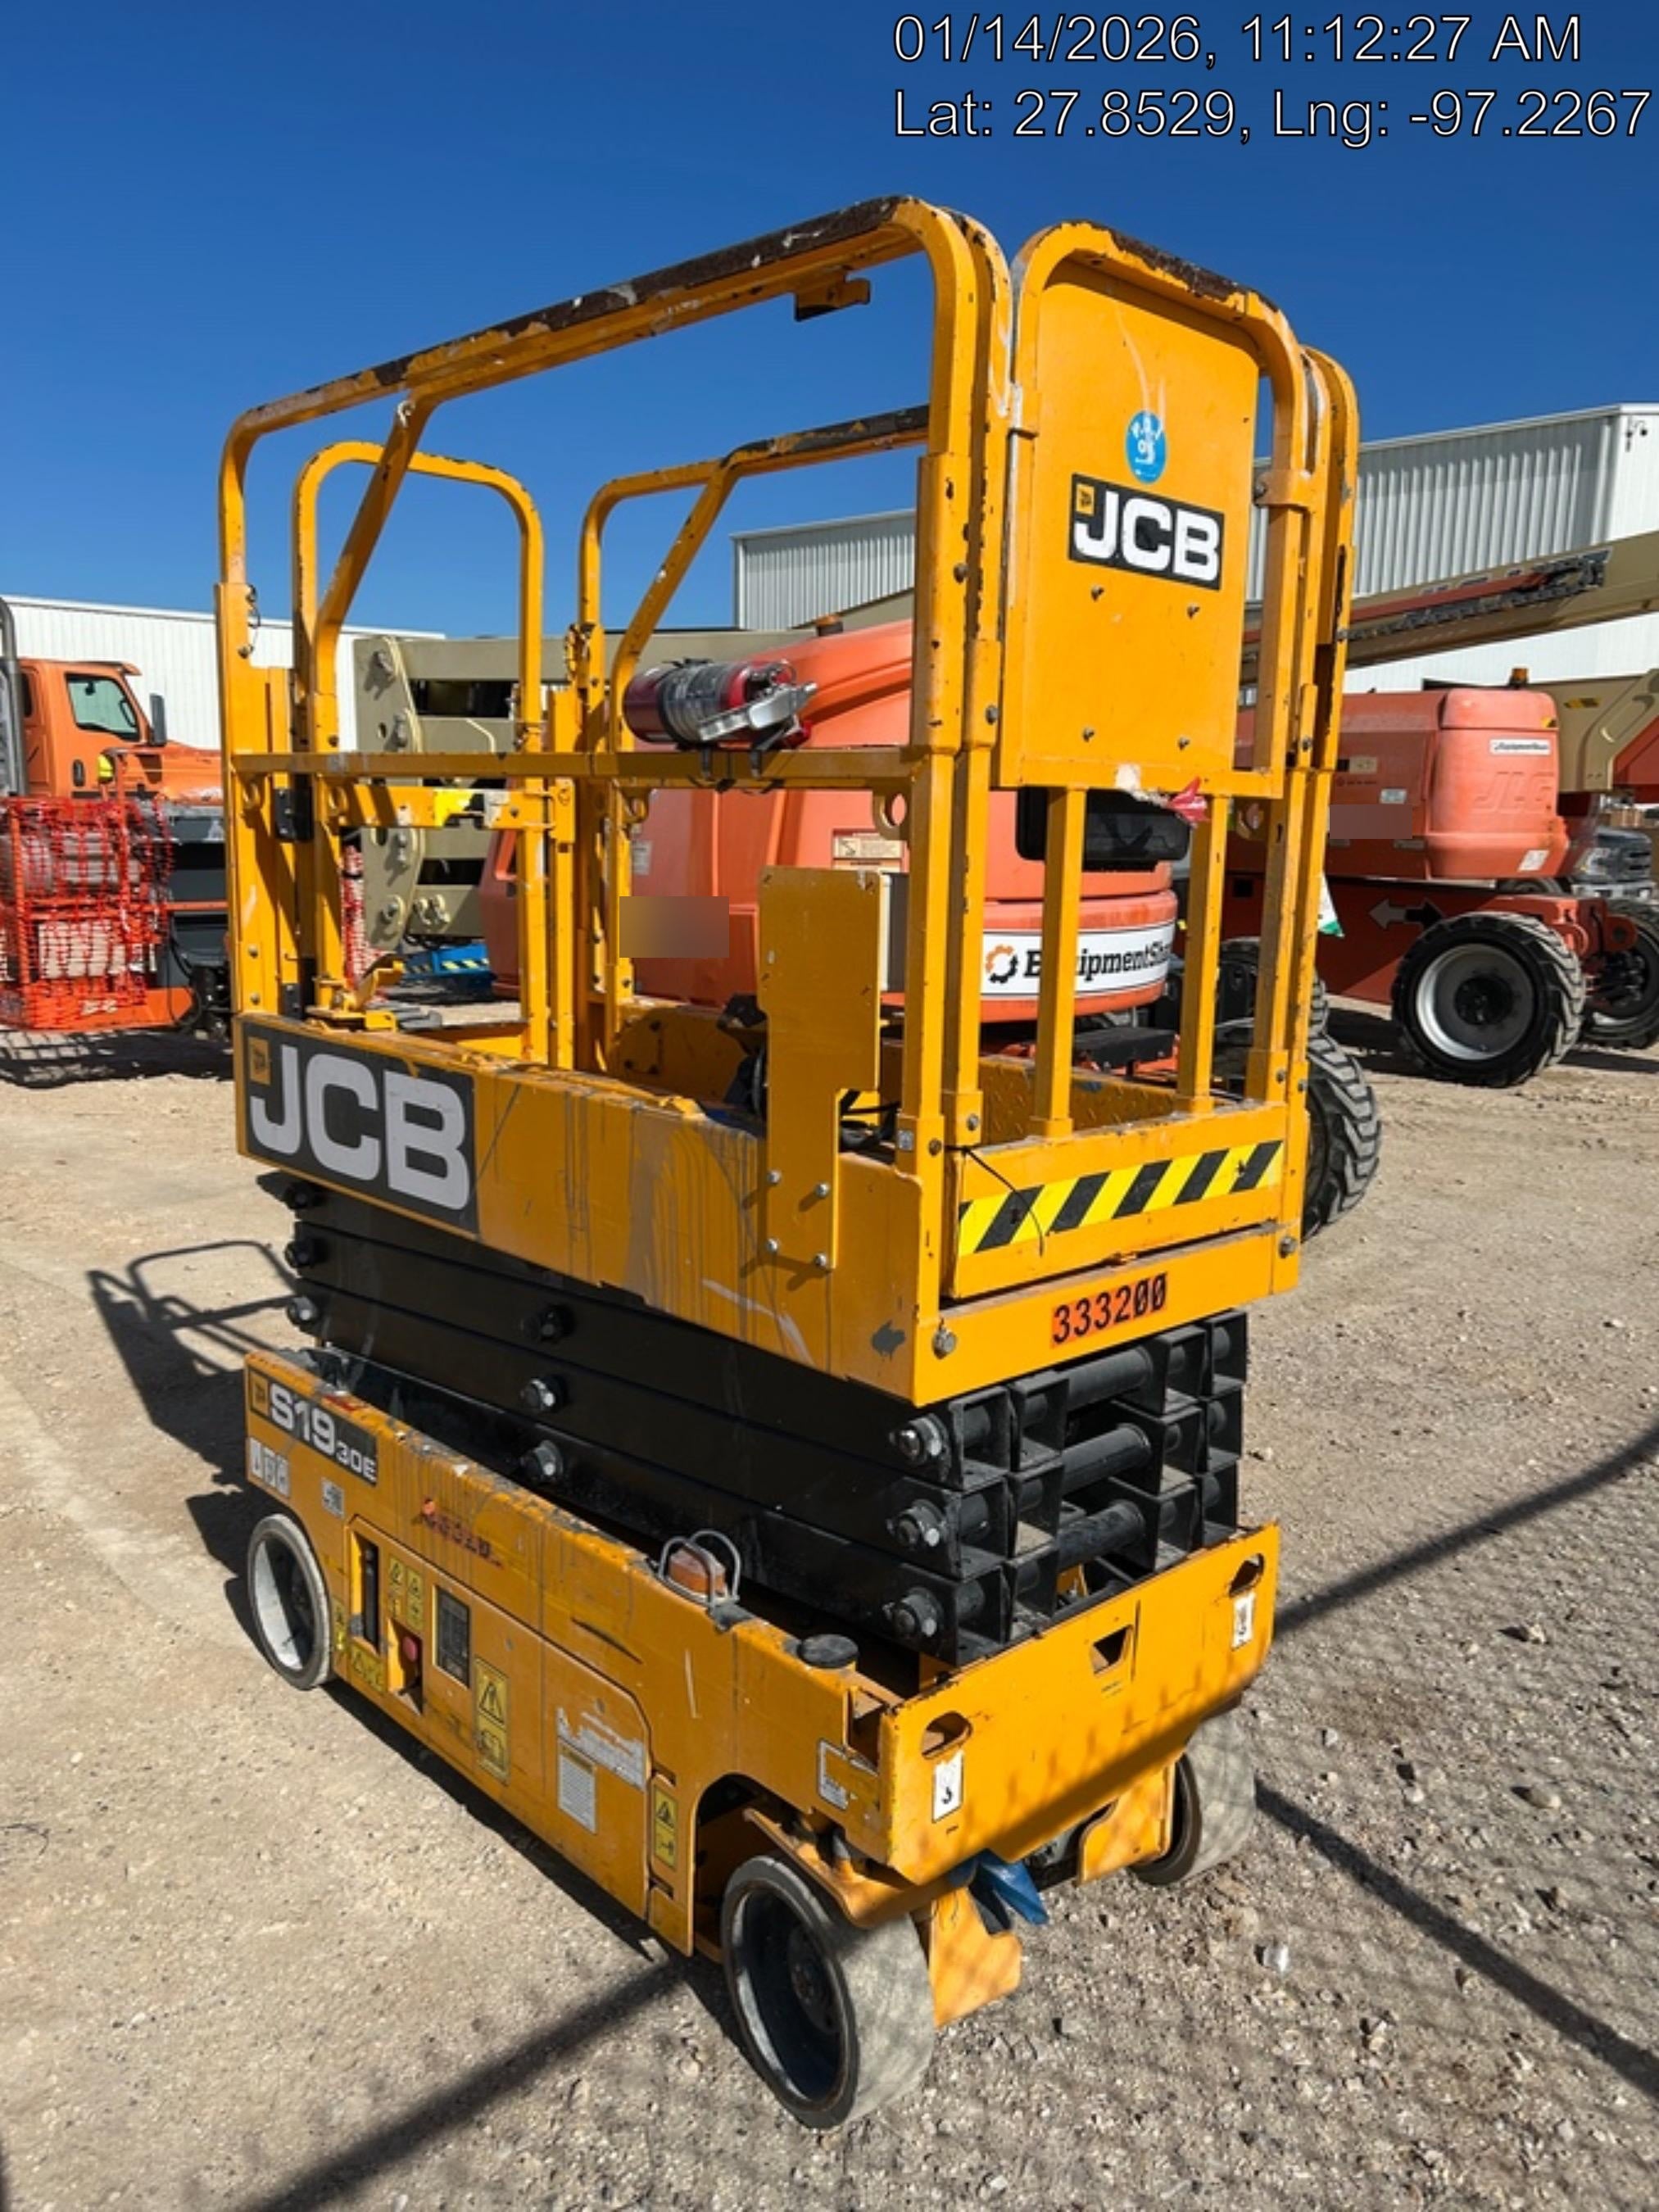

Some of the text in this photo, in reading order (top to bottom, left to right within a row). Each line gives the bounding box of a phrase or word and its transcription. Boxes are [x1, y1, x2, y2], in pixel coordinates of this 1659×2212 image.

[1073, 490, 1220, 581] JCB
[249, 1044, 471, 1211] JCB
[1053, 1271, 1167, 1344] 333200
